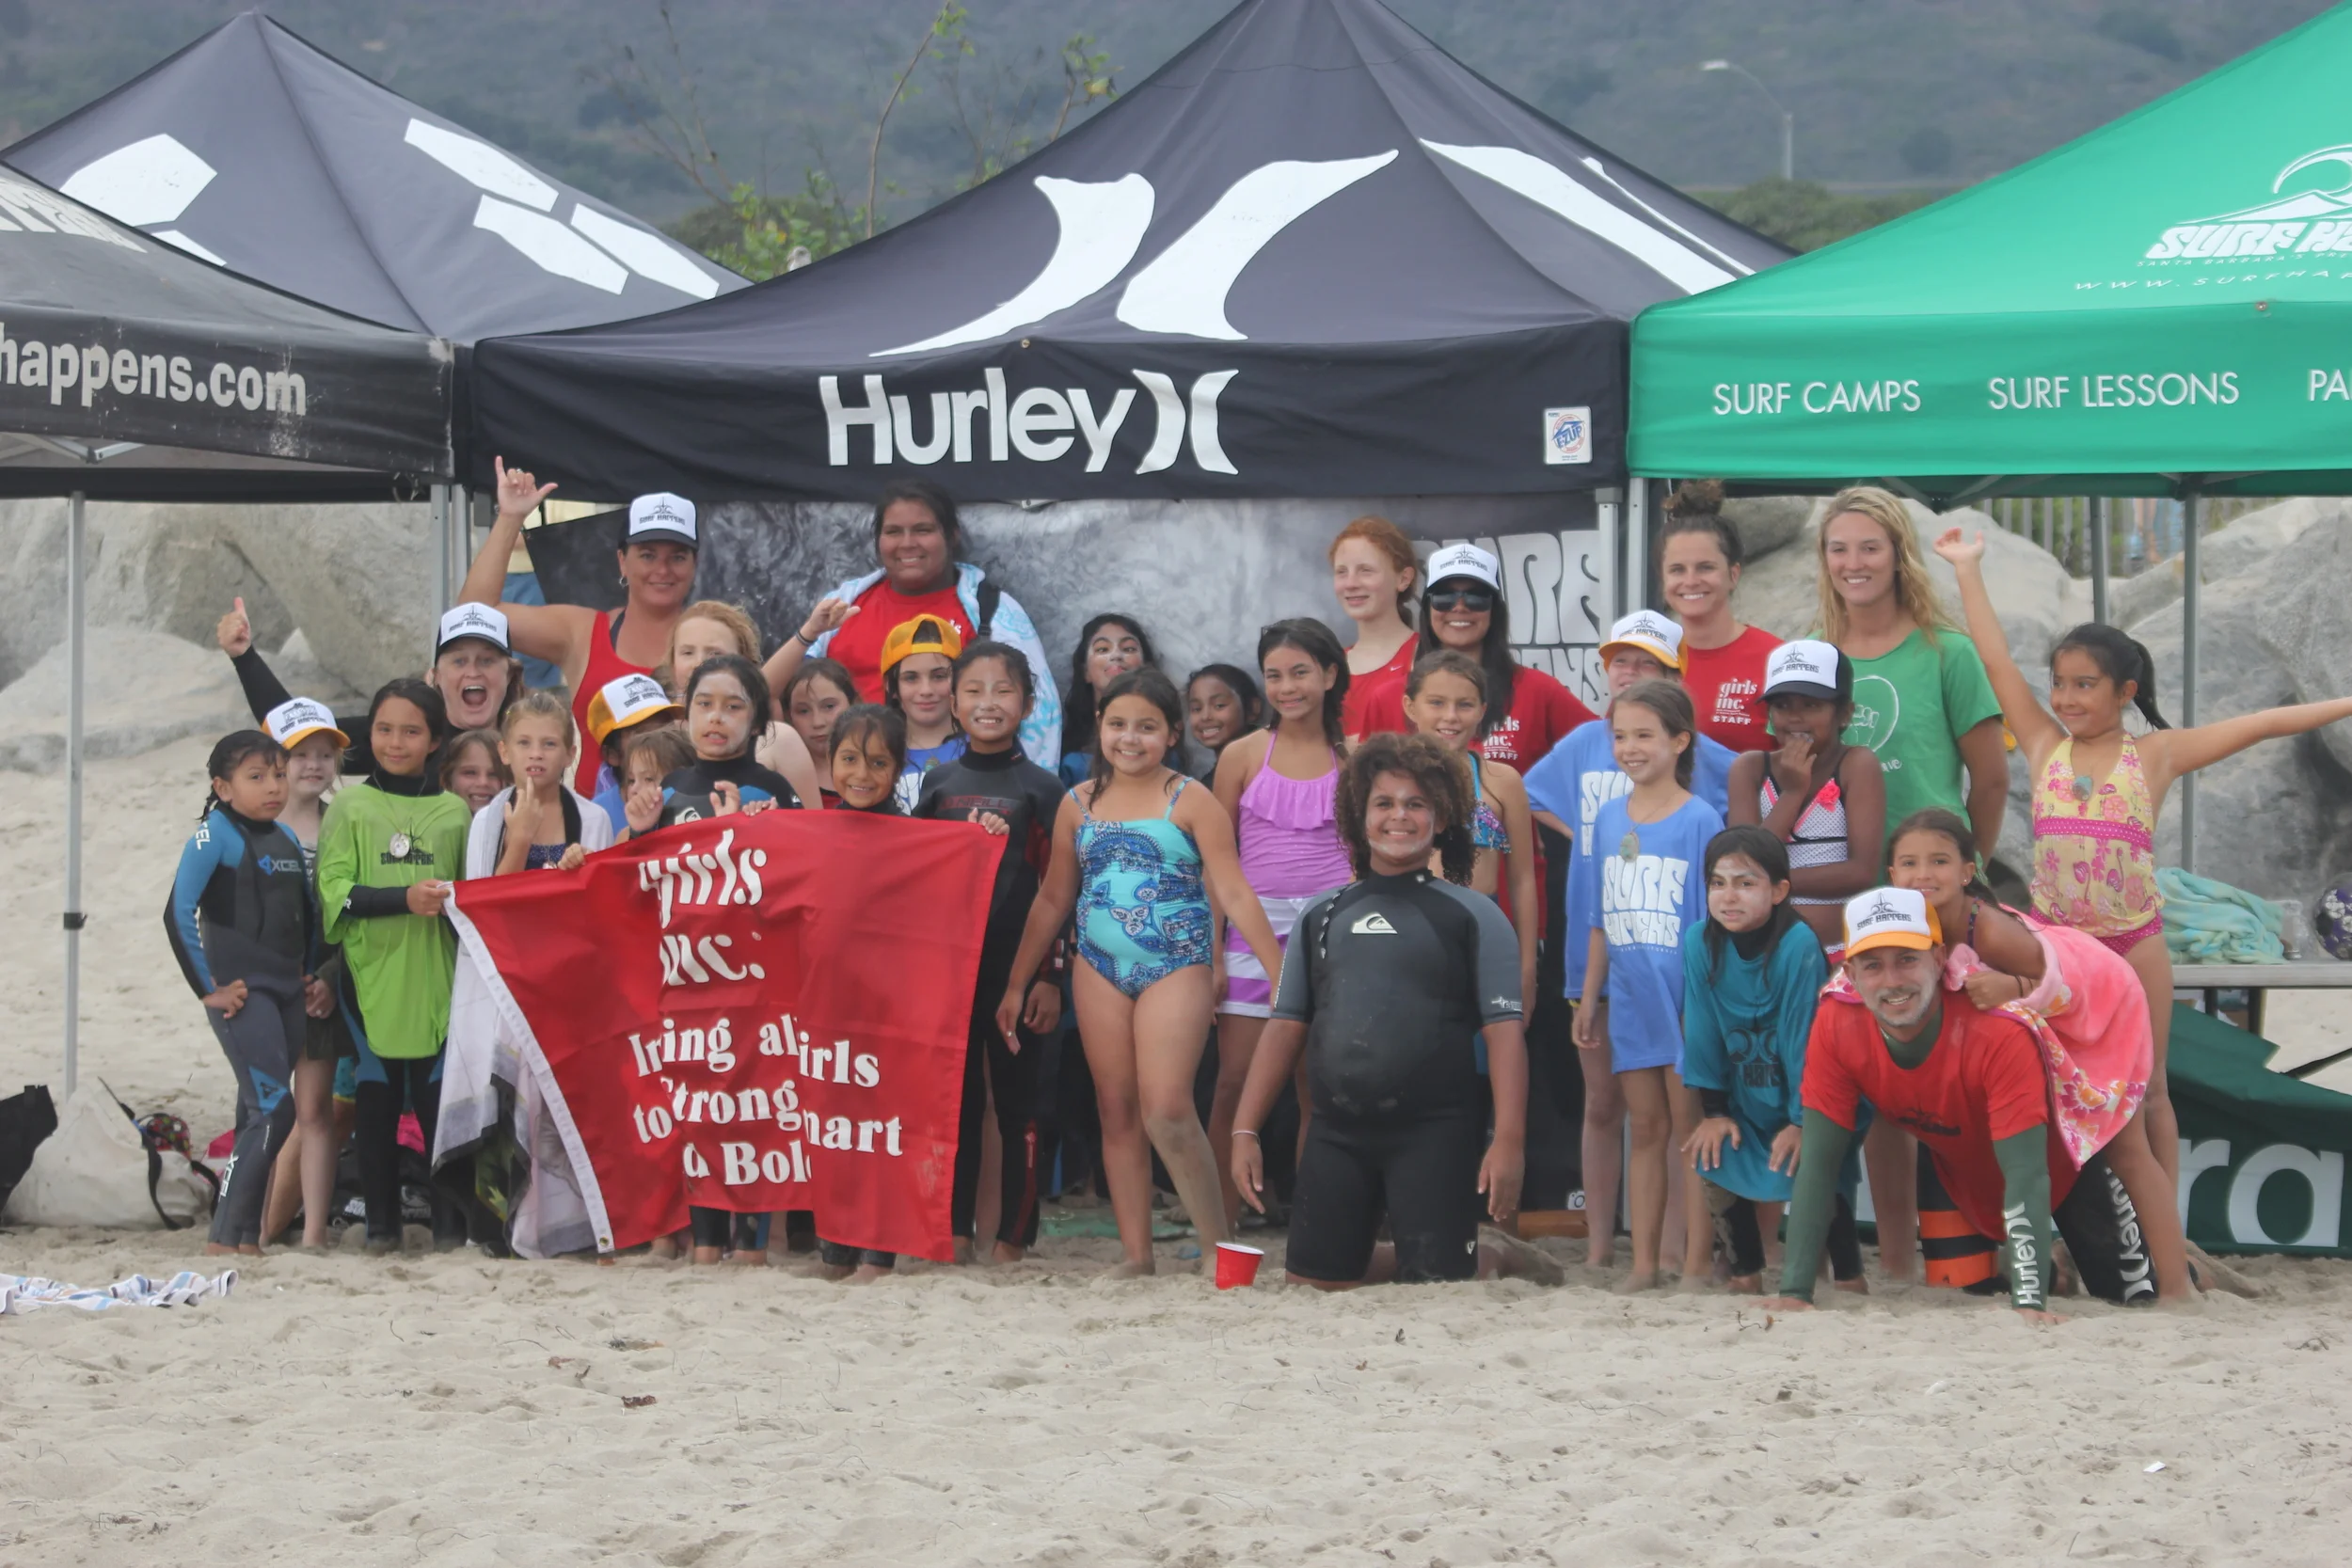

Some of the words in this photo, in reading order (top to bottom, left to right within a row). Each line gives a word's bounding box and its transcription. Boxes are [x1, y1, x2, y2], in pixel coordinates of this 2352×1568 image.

[2145, 222, 2309, 259] SURF
[2137, 260, 2193, 268] SANTA
[1988, 376, 2070, 409] SURF
[2082, 372, 2240, 407] LESSONS
[2308, 369, 2352, 403] PA
[1713, 383, 1791, 415] SURF
[1803, 380, 1921, 414] CAMPS
[818, 368, 1136, 472] Hurley
[1786, 662, 1820, 674] HAPPENS
[1719, 677, 1758, 698] girls
[1716, 696, 1745, 710] inc.
[1712, 715, 1753, 725] STAFF
[1484, 751, 1519, 761] STAFF
[271, 859, 302, 873] XCEL
[1602, 854, 1690, 914] SURF
[1875, 912, 1913, 923] HAPPENS
[2011, 1233, 2043, 1307] Hurley
